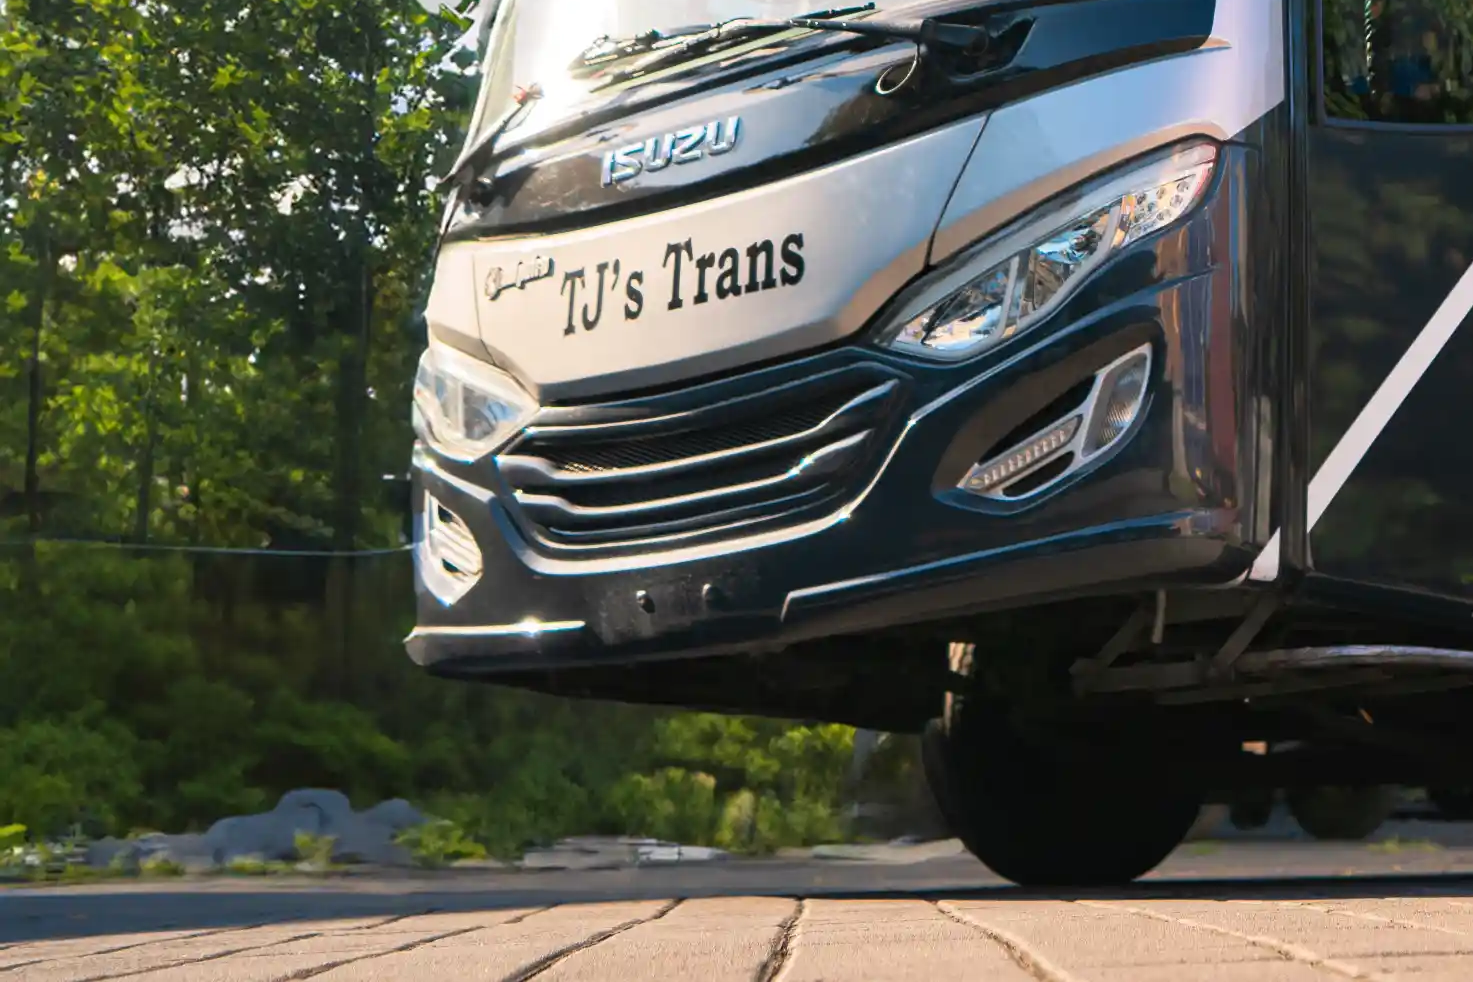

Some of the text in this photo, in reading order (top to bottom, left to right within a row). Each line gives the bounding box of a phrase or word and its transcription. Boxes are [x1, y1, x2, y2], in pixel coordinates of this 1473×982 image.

[601, 116, 742, 188] ISUZU
[561, 258, 644, 337] TJ's
[662, 232, 806, 311] Trans
